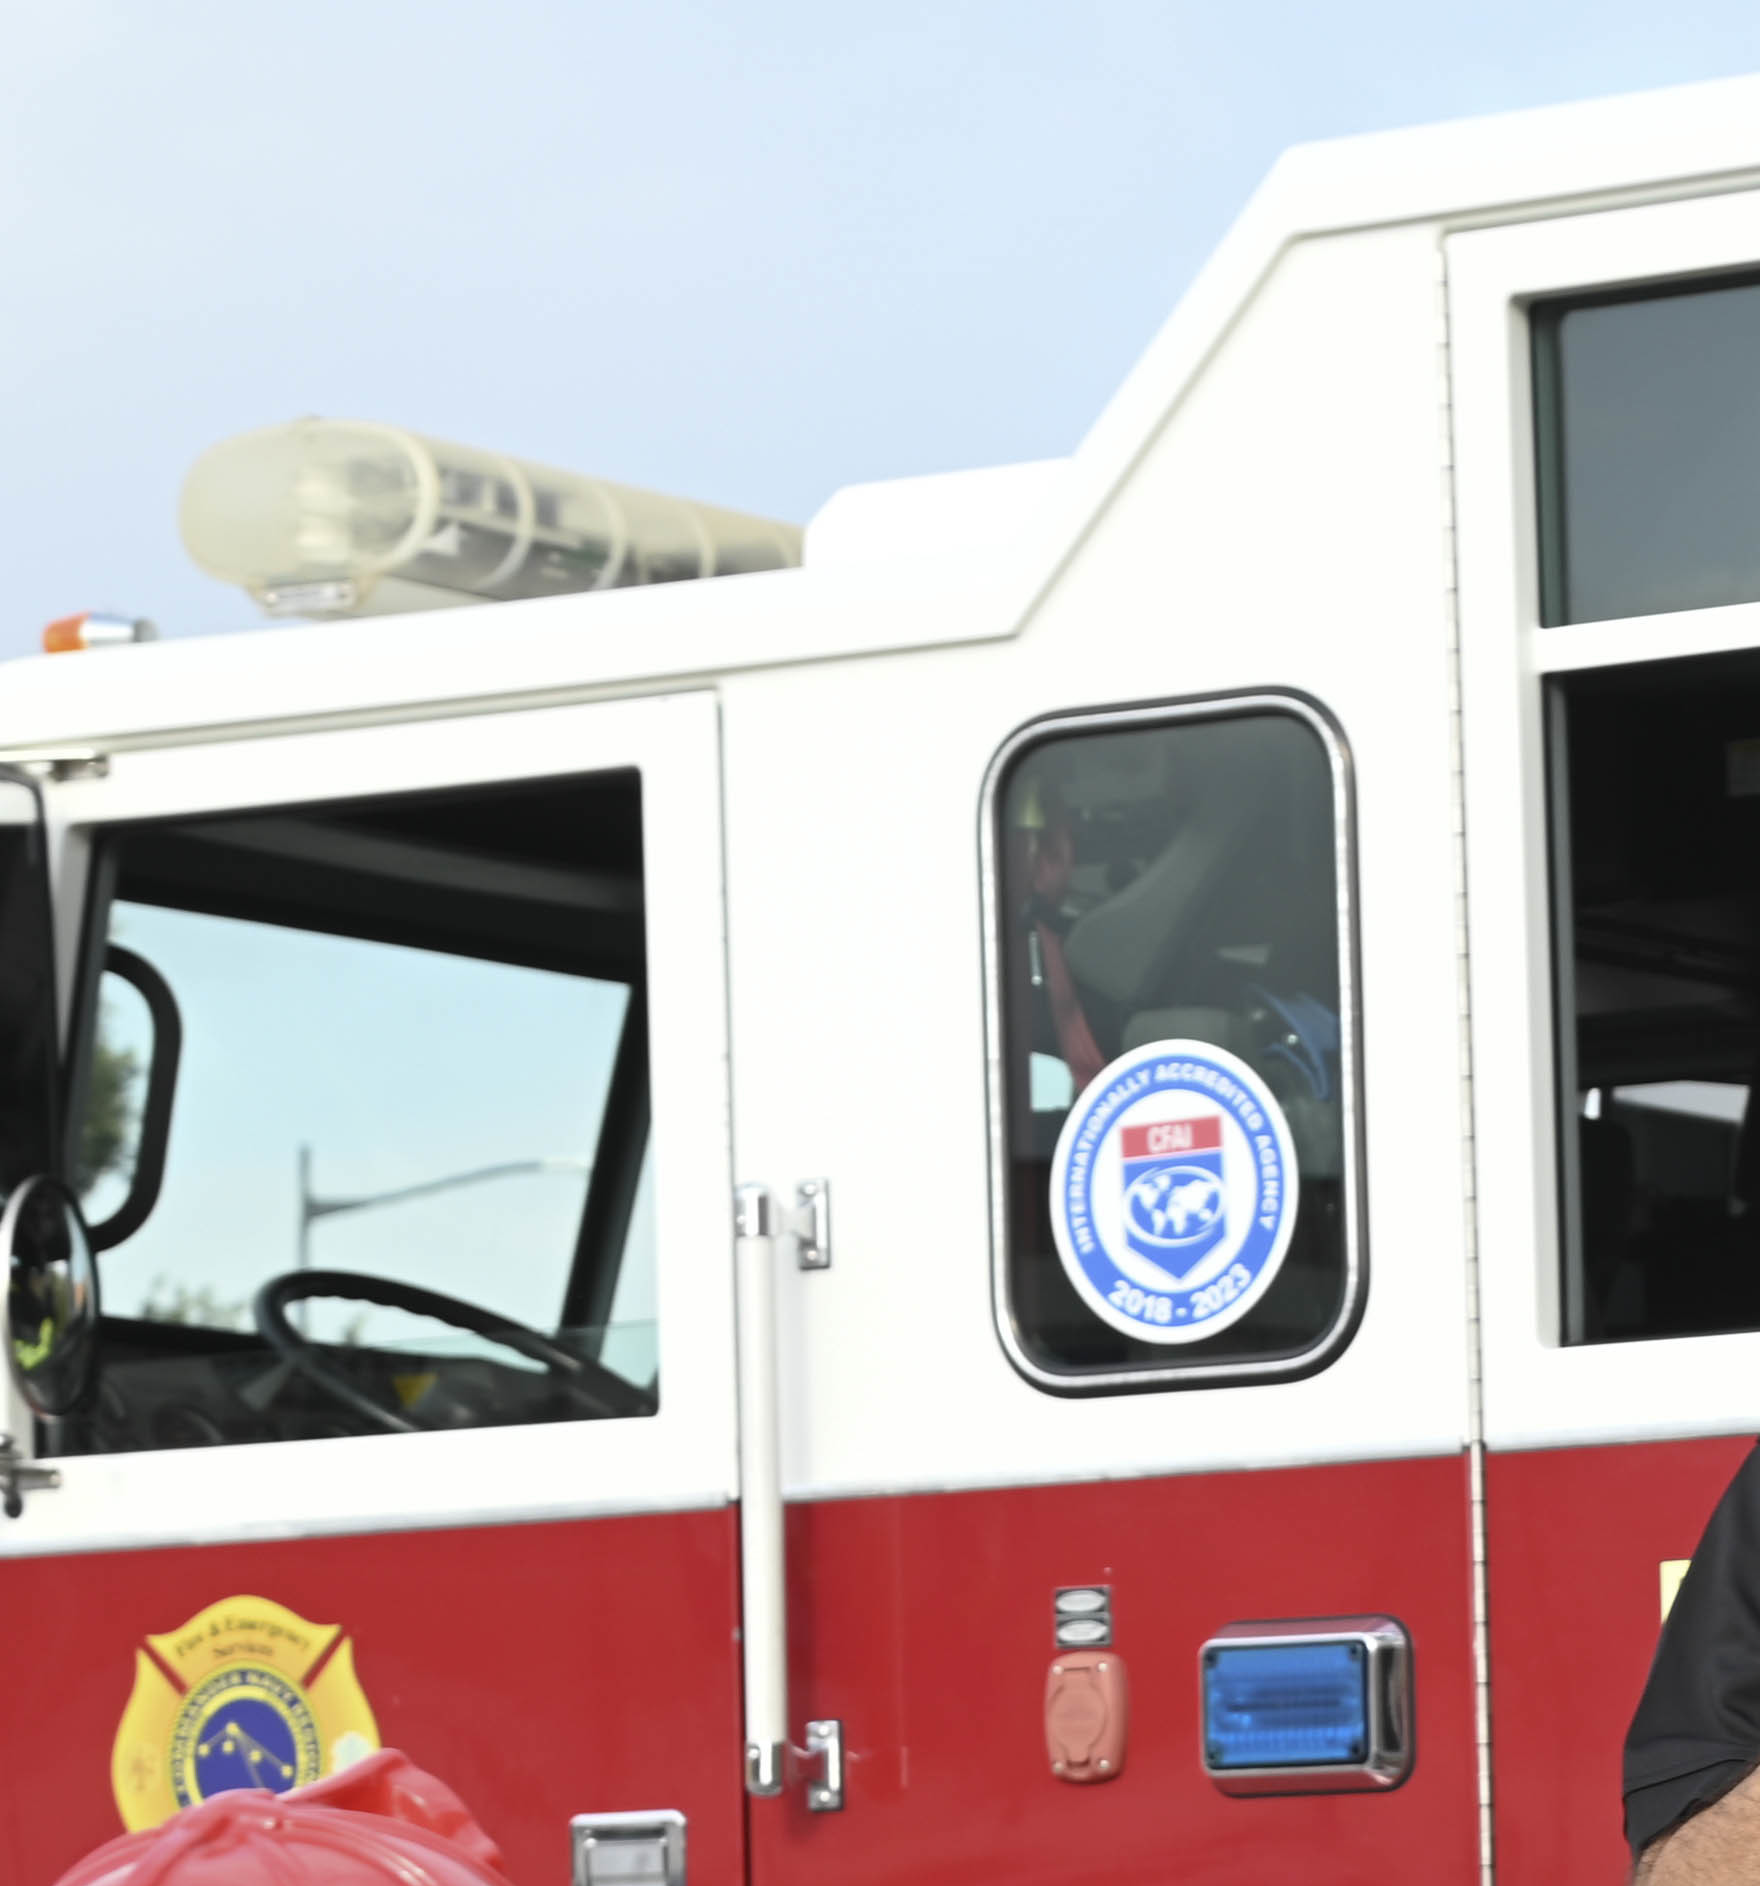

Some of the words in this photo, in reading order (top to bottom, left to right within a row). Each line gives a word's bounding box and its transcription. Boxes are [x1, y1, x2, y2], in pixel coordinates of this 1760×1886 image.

[1068, 1068, 1151, 1256] INTERNATIONALLY
[1155, 1062, 1263, 1132] ACCREDITED
[1254, 1134, 1281, 1231] AGENCY
[1147, 1123, 1193, 1154] CFAI
[1107, 1279, 1173, 1324] 2018
[1190, 1262, 1252, 1319] 2023
[224, 1616, 310, 1650] Emergency
